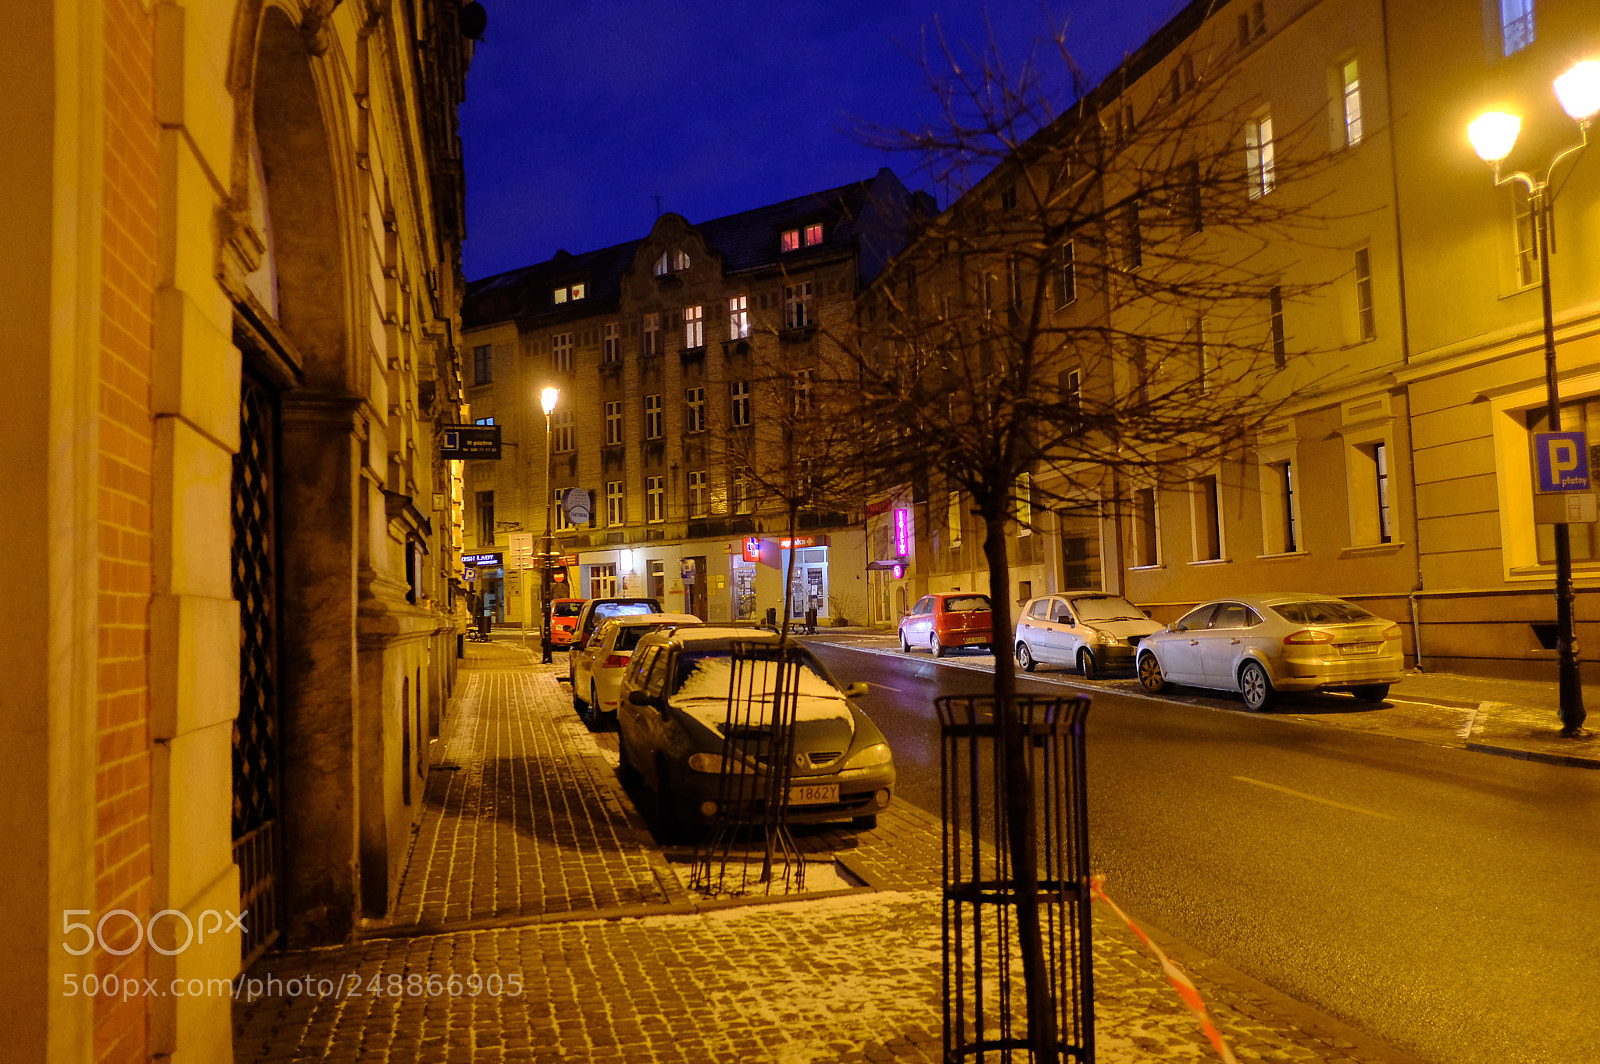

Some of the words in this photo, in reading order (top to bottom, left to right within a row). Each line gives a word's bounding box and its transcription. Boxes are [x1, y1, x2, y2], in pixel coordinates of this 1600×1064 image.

[1549, 440, 1577, 484] P
[465, 569, 475, 580] P
[799, 786, 837, 801] 1862Y
